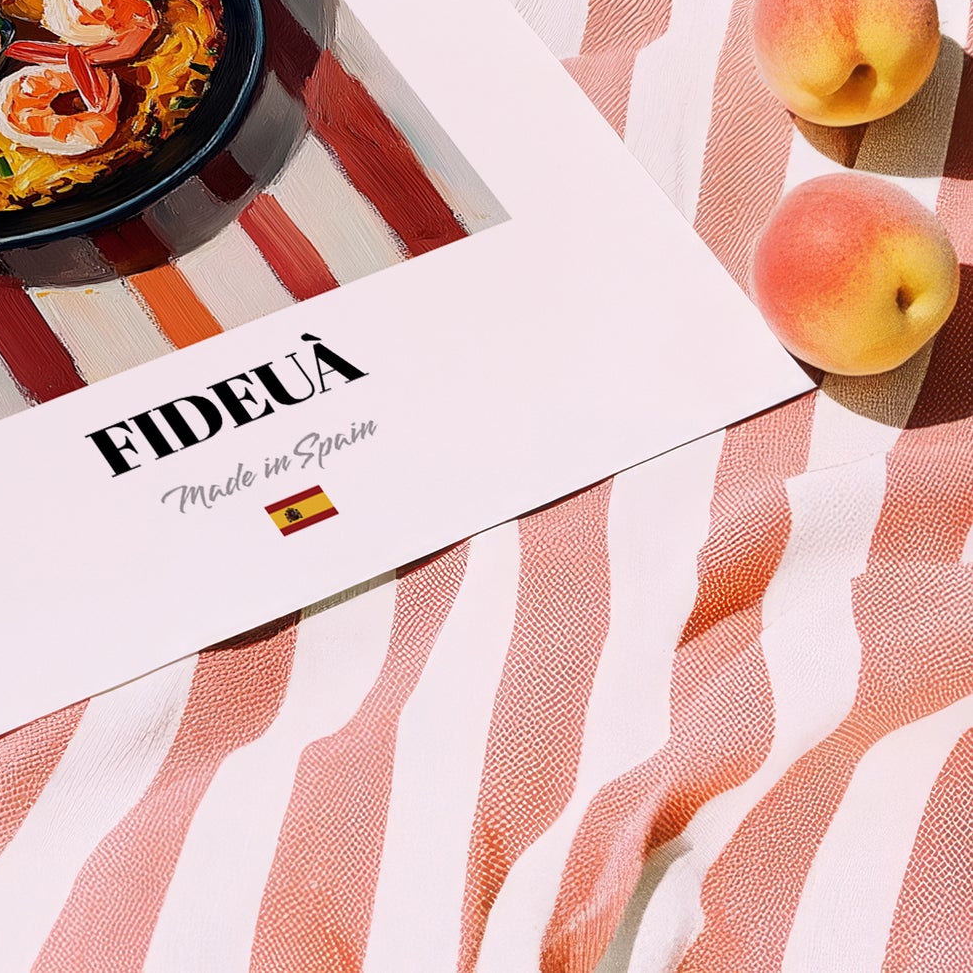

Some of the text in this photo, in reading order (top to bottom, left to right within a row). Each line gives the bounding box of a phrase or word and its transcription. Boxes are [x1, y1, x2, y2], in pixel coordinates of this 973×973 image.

[84, 332, 369, 477] FIDEUÀ
[161, 419, 378, 514] Made in Spain
